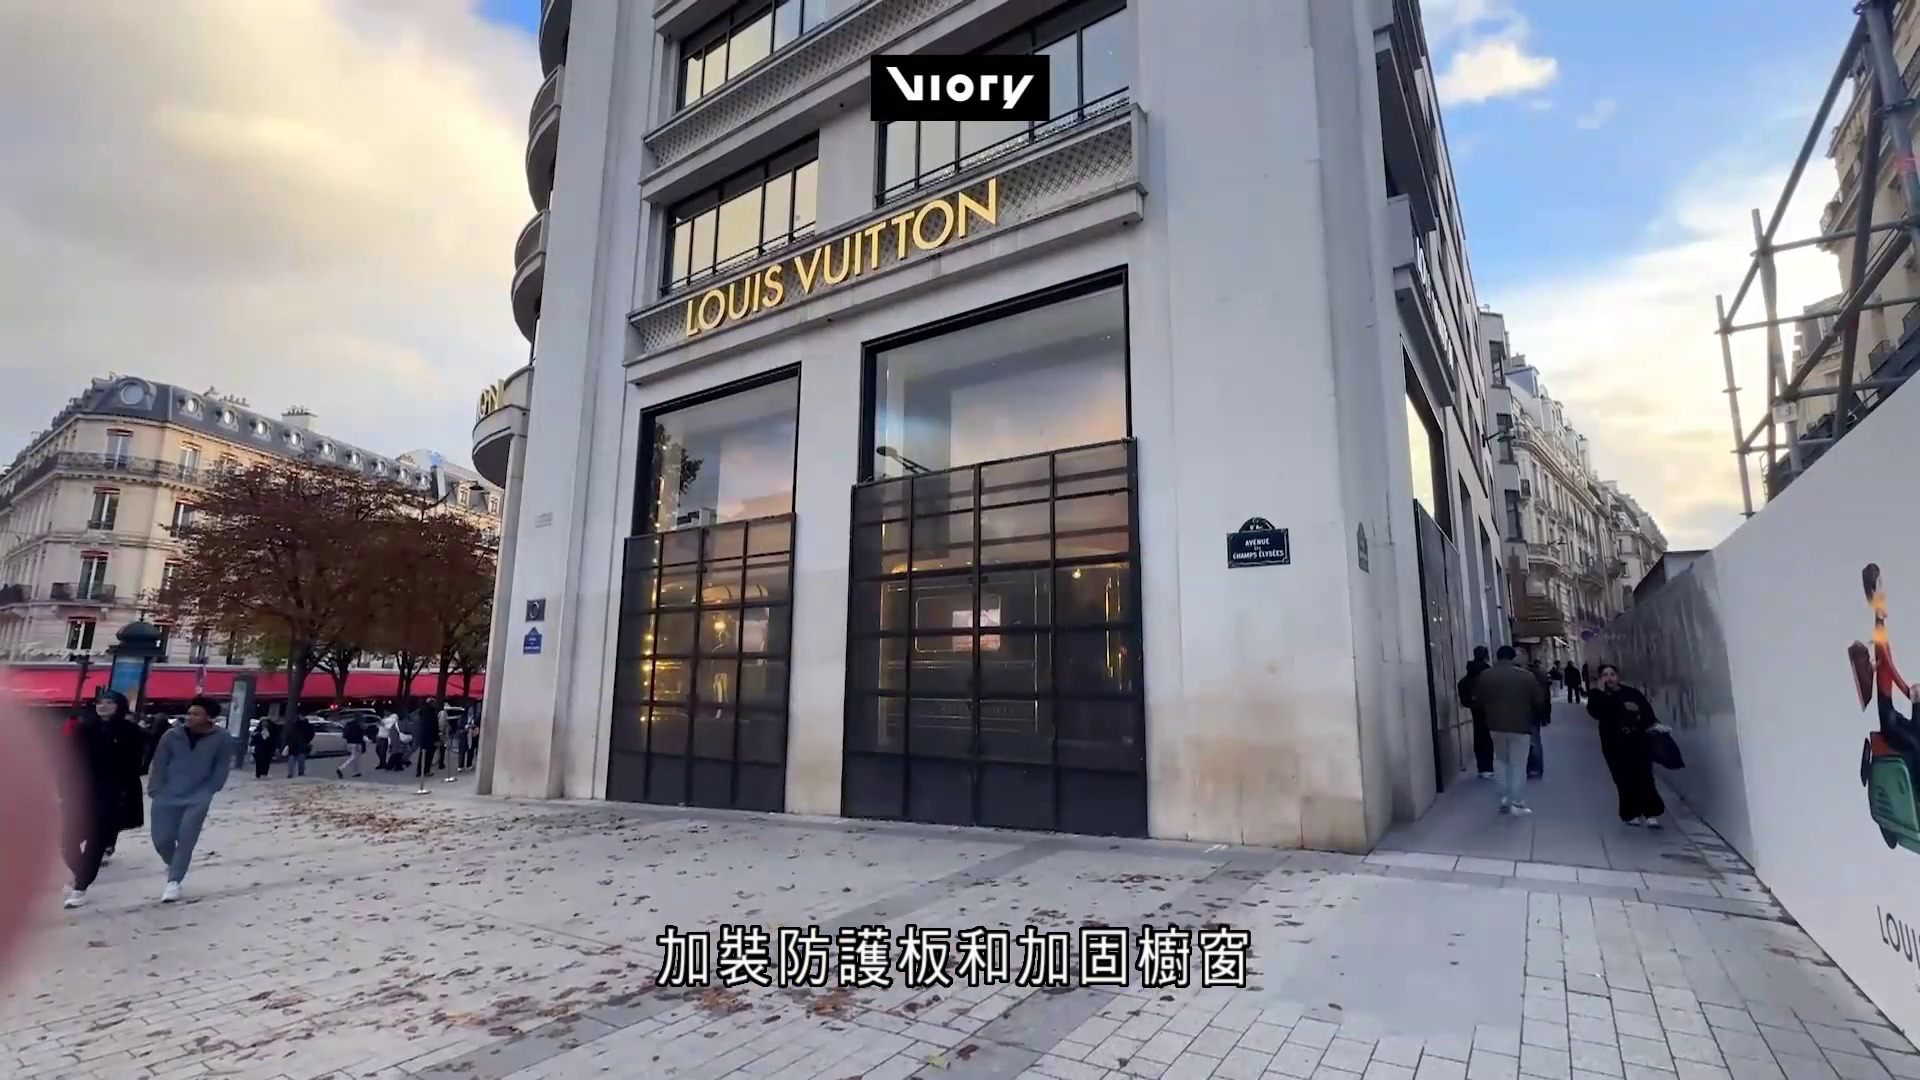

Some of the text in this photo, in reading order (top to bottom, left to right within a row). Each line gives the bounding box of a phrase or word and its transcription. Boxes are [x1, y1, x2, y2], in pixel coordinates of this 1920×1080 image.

[686, 178, 997, 336] LOUIS VUITTON
[1233, 551, 1257, 560] CHAMPS
[1245, 538, 1270, 547] AVENUE
[1877, 904, 1920, 970] LOUI
